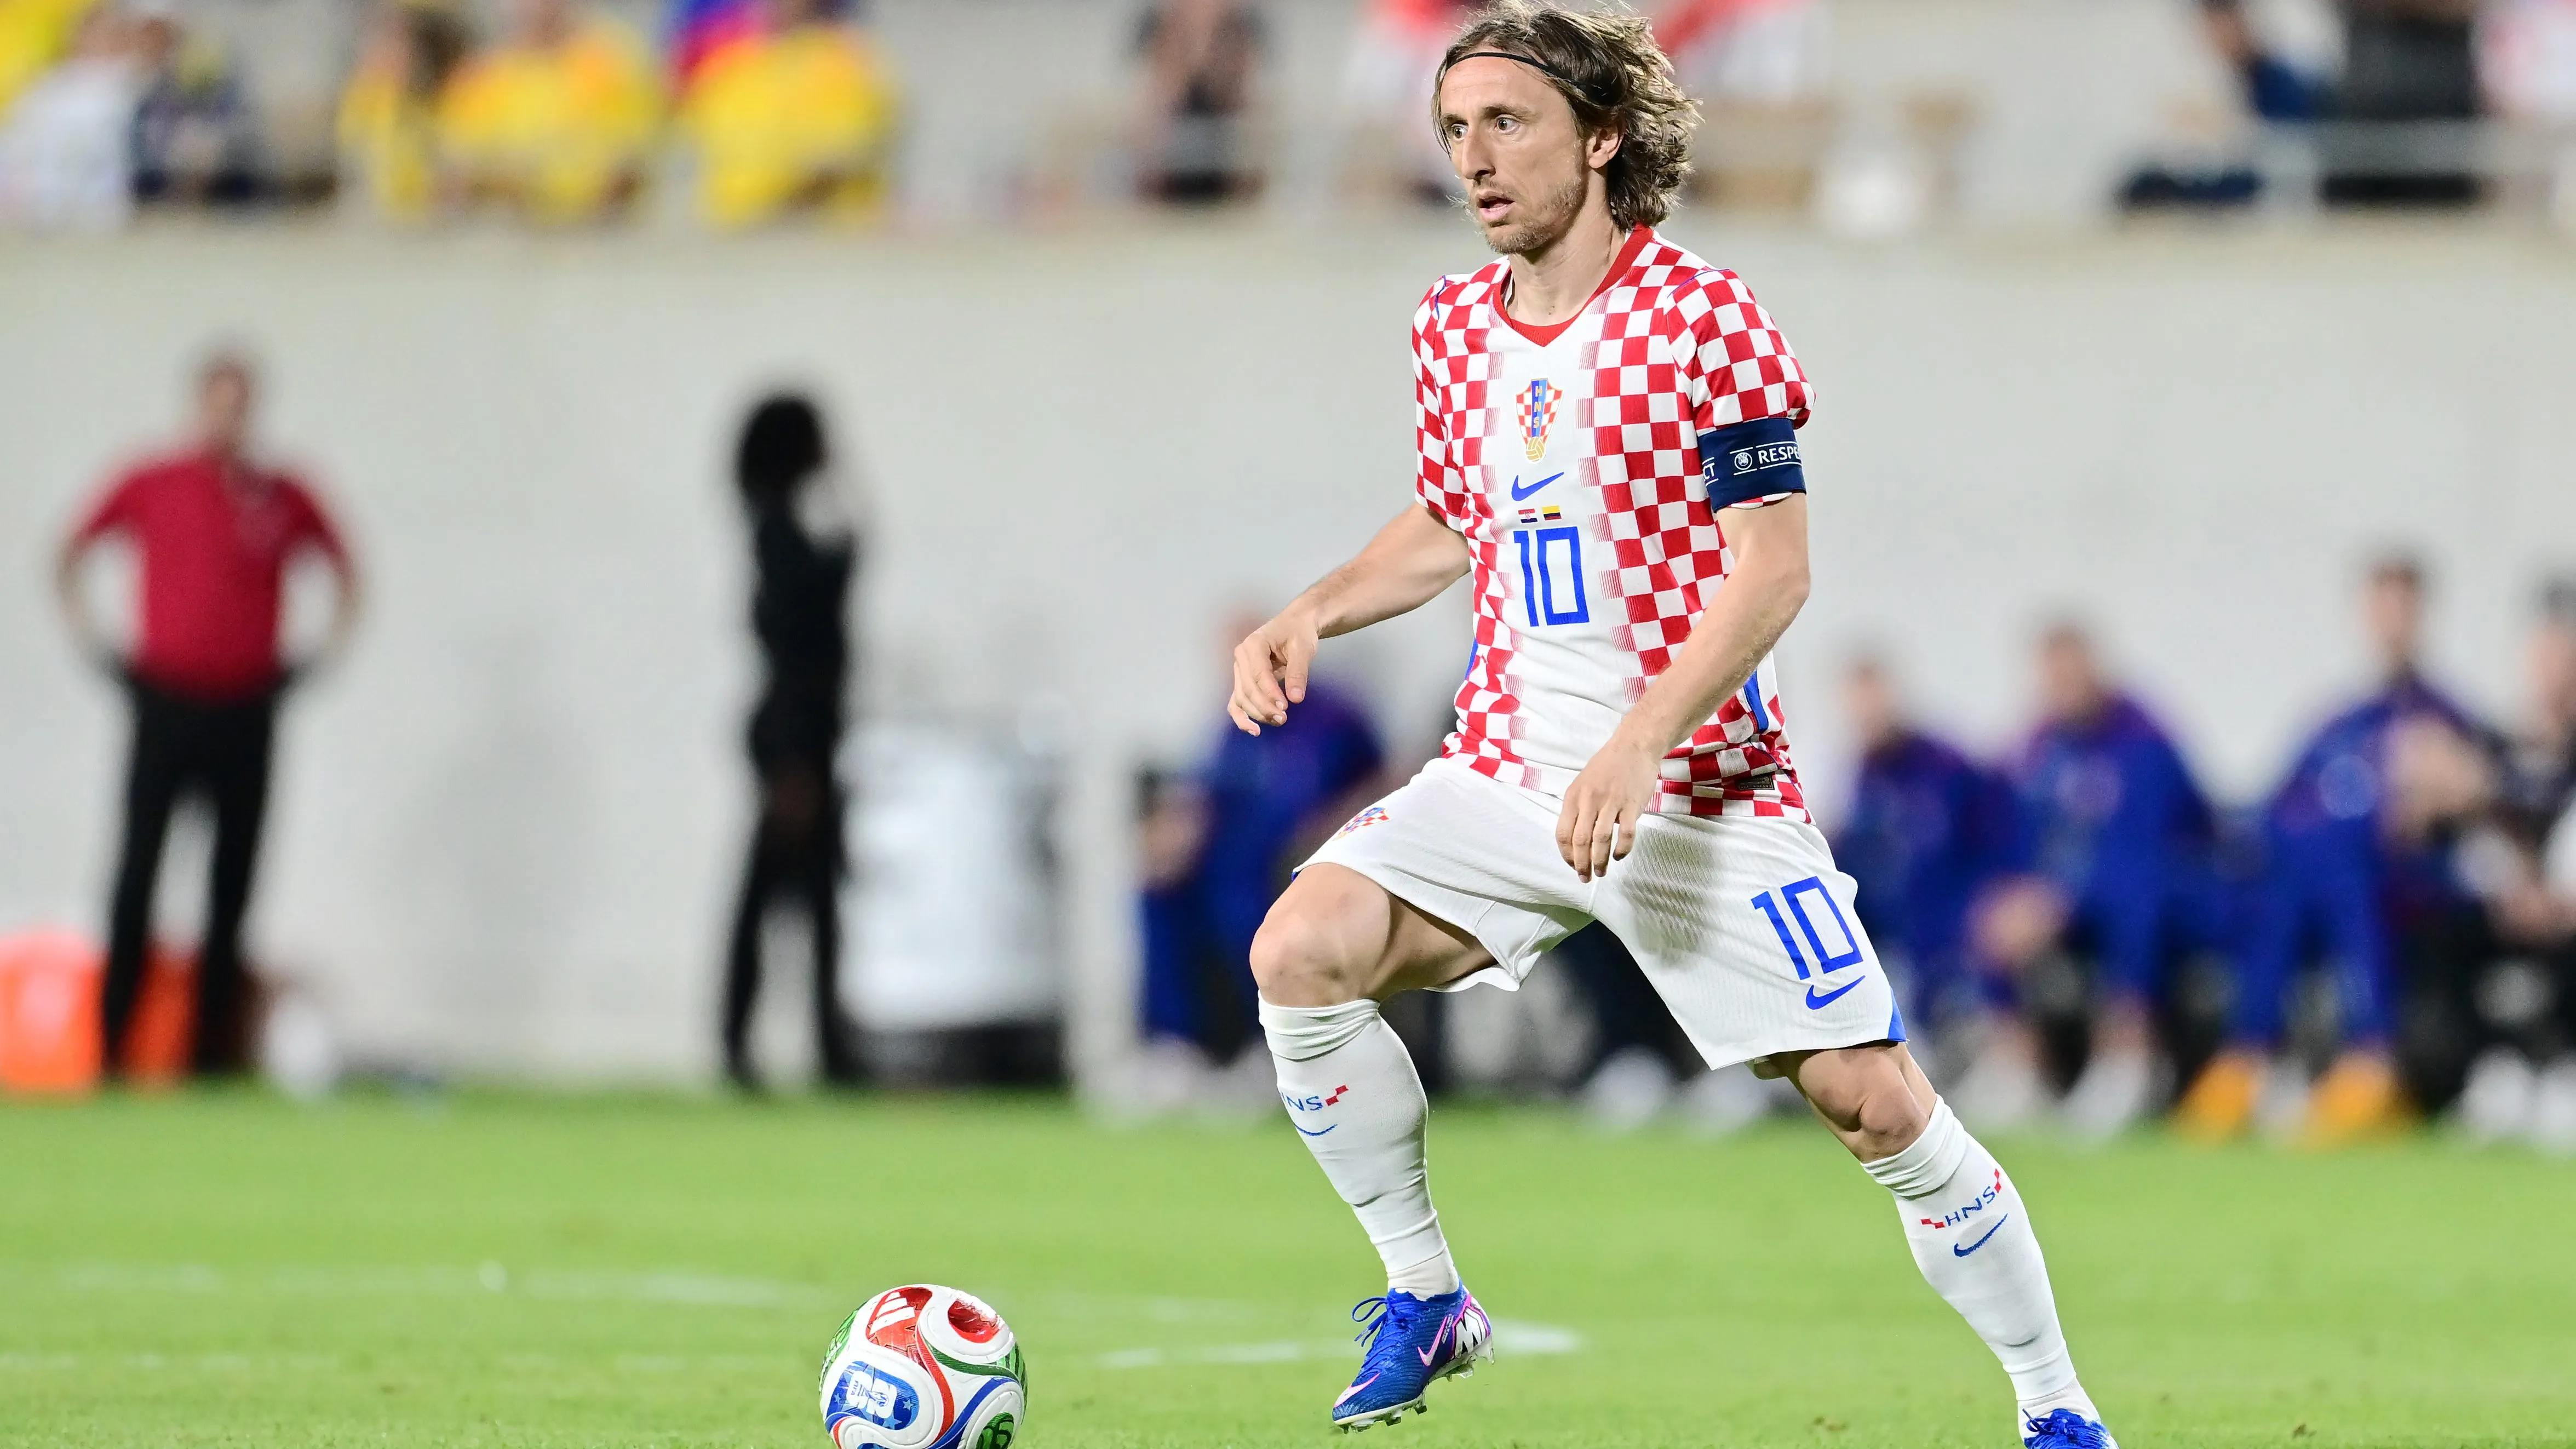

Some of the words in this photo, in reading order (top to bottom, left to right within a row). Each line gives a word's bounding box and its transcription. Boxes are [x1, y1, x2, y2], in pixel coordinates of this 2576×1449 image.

[1533, 385, 1543, 428] HNS
[1702, 462, 1715, 480] CT
[1758, 446, 1802, 464] RESPE
[1513, 526, 1590, 627] 10
[1751, 876, 1863, 980] 10
[1945, 1185, 1995, 1226] HNS
